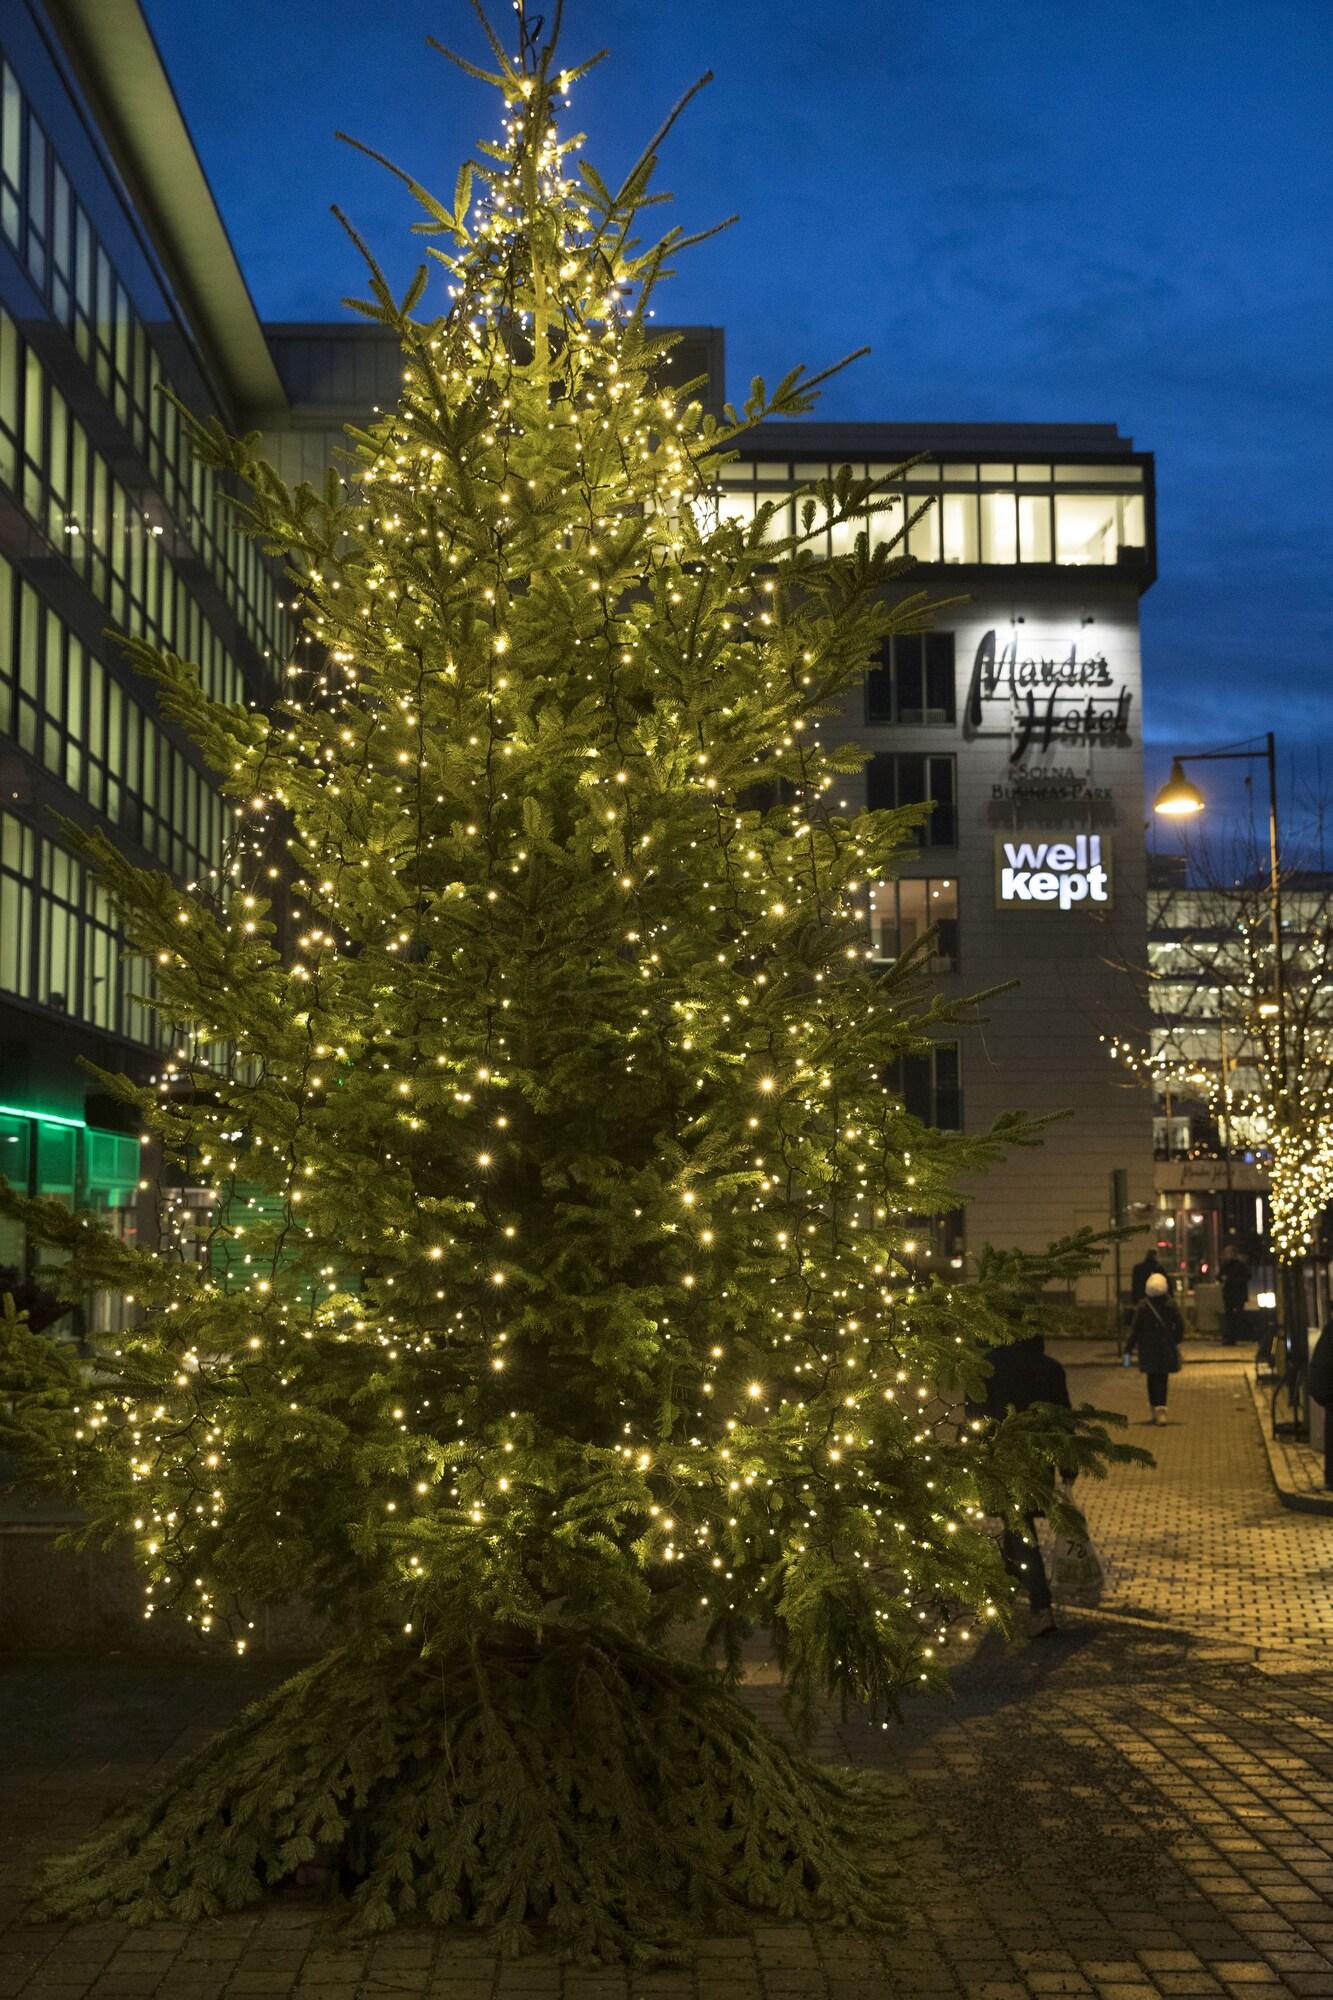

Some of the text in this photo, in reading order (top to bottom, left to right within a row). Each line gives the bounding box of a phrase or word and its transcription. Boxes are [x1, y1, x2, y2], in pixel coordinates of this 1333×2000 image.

[1010, 685, 1129, 763] Hotel
[1003, 835, 1101, 871] well
[1001, 866, 1108, 910] kept
